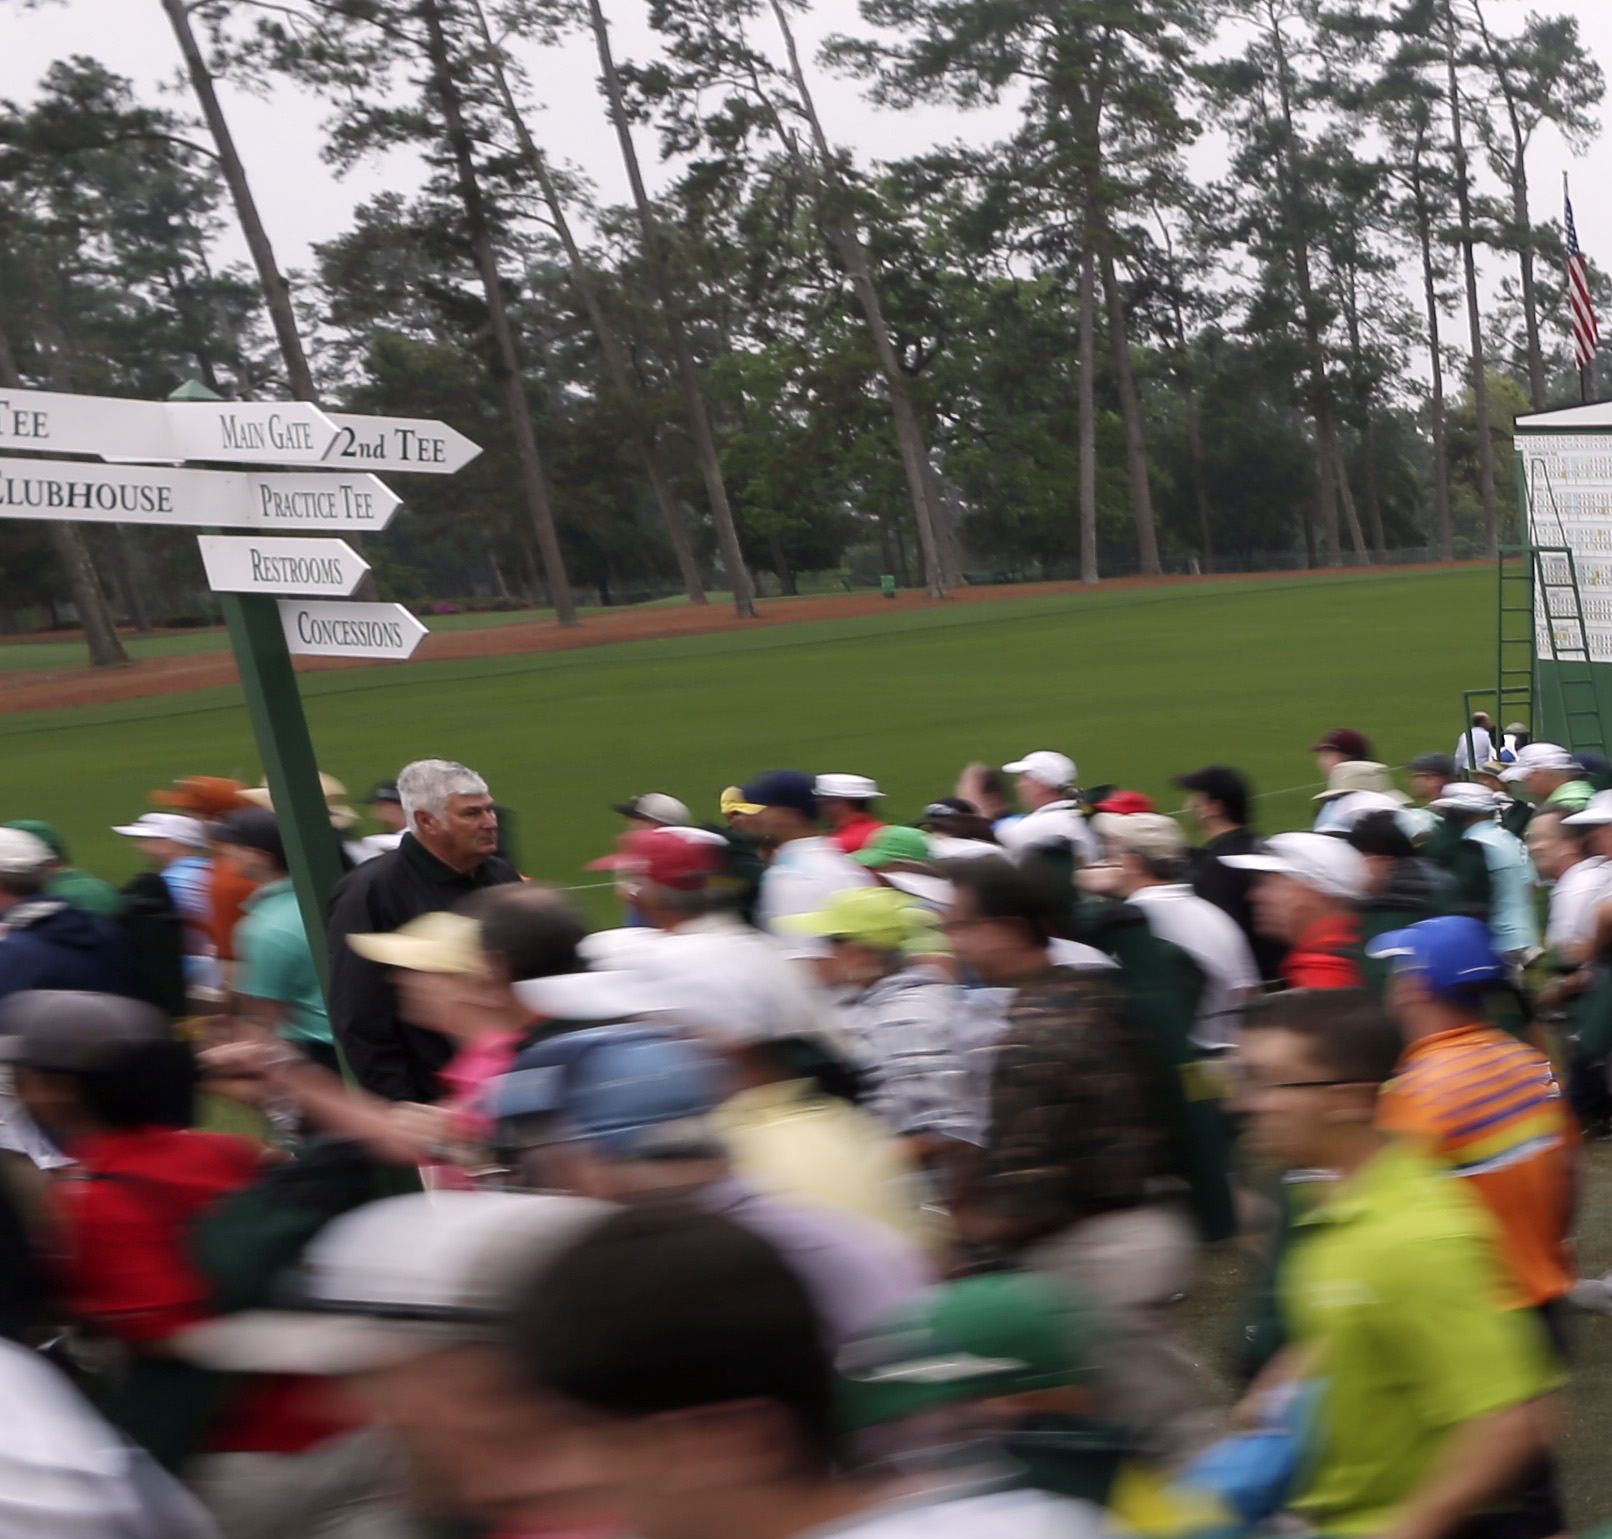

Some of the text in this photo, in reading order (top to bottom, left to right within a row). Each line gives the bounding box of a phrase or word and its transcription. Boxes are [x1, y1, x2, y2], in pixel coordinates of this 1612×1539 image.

[220, 414, 313, 450] MAIN GATE
[341, 426, 445, 463] 2nd TEE
[0, 469, 173, 513] LUBHOUSE
[261, 484, 373, 519] PRACTICE TEE
[250, 548, 342, 585] RESTROOMS
[298, 612, 402, 648] CONCESSIONS
